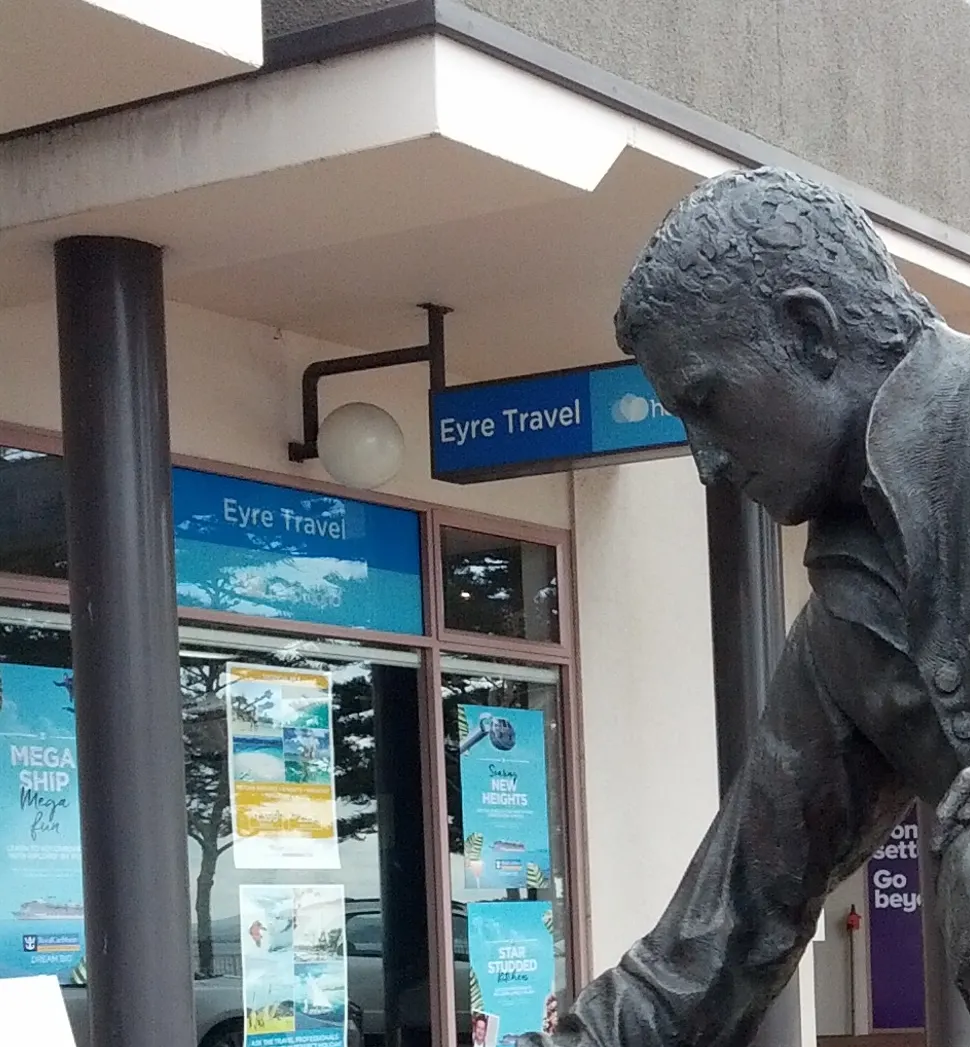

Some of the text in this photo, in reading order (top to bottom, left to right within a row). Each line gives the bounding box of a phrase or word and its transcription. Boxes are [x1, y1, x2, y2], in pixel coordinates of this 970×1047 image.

[440, 416, 495, 446] Eyre
[503, 399, 581, 433] Travel
[223, 498, 346, 540] Eyre Travel
[10, 745, 76, 768] MEGA
[19, 769, 70, 792] SHIP
[491, 779, 517, 792] NEW
[20, 786, 70, 821] Mega
[482, 793, 528, 806] HEIGHTS
[31, 811, 61, 841] fun
[873, 869, 907, 889] Go
[499, 947, 526, 959] STAR
[488, 959, 537, 974] STUDDED
